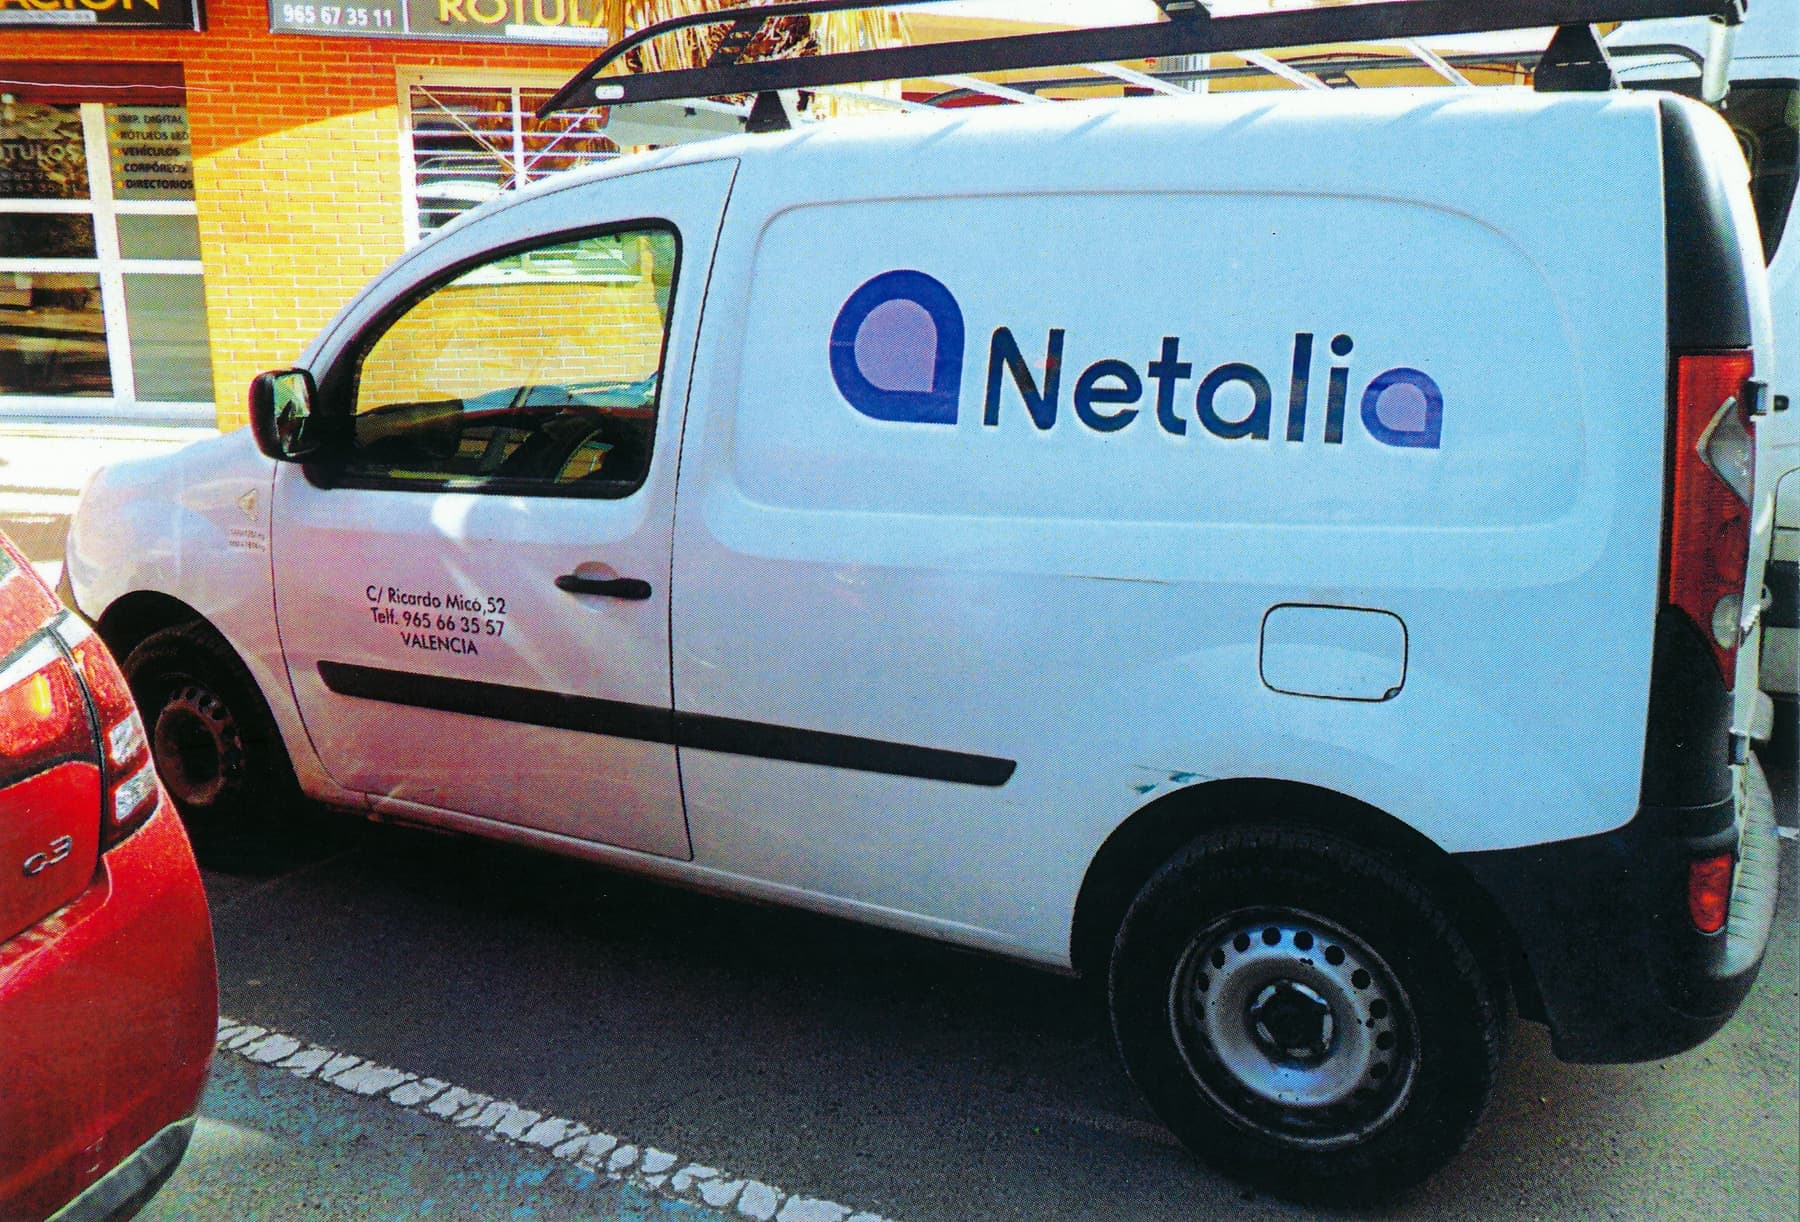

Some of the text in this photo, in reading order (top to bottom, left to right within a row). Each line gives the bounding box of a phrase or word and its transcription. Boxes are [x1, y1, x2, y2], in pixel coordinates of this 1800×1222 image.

[282, 4, 393, 27] 965 67 35 11
[125, 178, 194, 189] DIRECTORIOS
[983, 326, 1444, 450] Netalia
[366, 585, 383, 603] C/
[388, 587, 441, 608] Ricardo
[370, 607, 505, 637] Telf. 965 66 35 57
[400, 632, 479, 655] VALENCIA
[23, 834, 73, 876] C3
